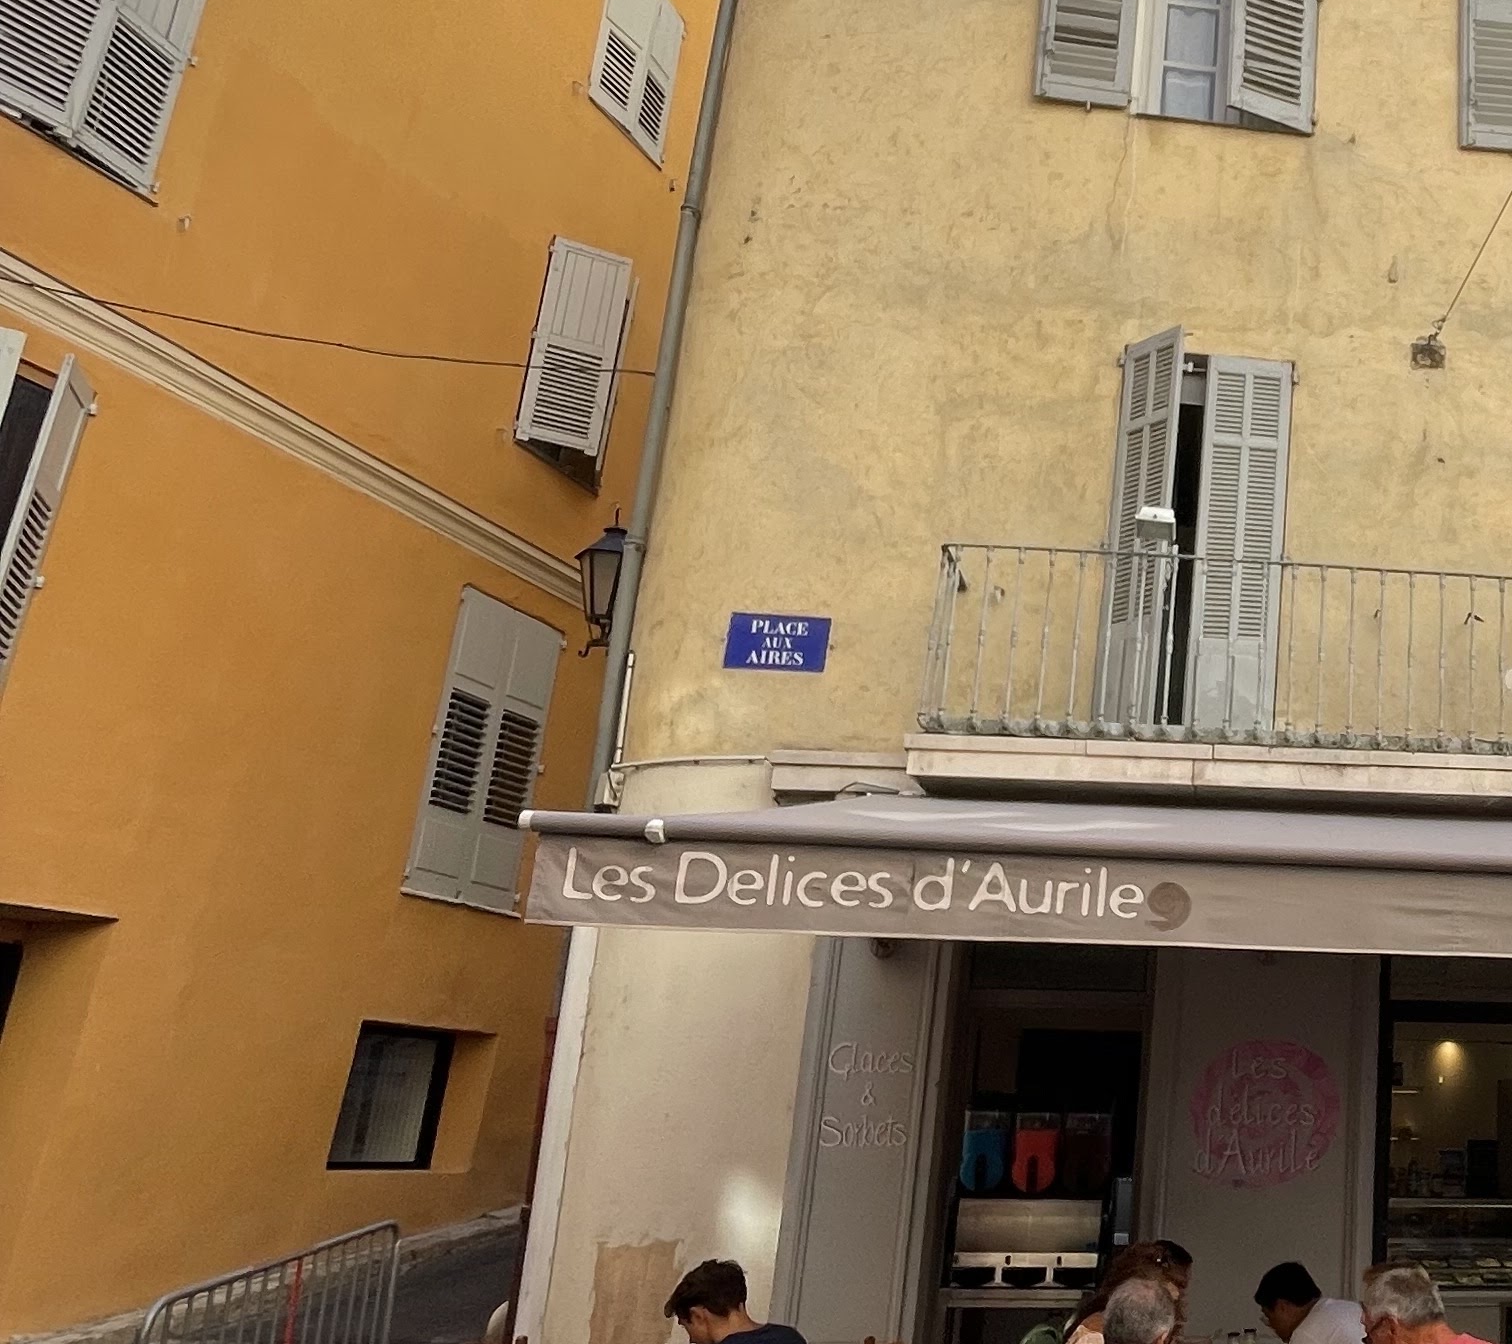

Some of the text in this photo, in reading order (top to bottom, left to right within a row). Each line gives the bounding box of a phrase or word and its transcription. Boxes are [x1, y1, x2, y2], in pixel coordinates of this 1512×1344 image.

[751, 619, 809, 636] PLACE
[761, 637, 793, 649] AUX
[746, 650, 804, 666] AIRES
[562, 846, 1145, 919] Les Delices d'Aurile
[828, 1041, 915, 1081] Glaces
[1232, 1047, 1288, 1080] Les
[861, 1081, 876, 1106] &
[819, 1114, 907, 1148] Sorbets
